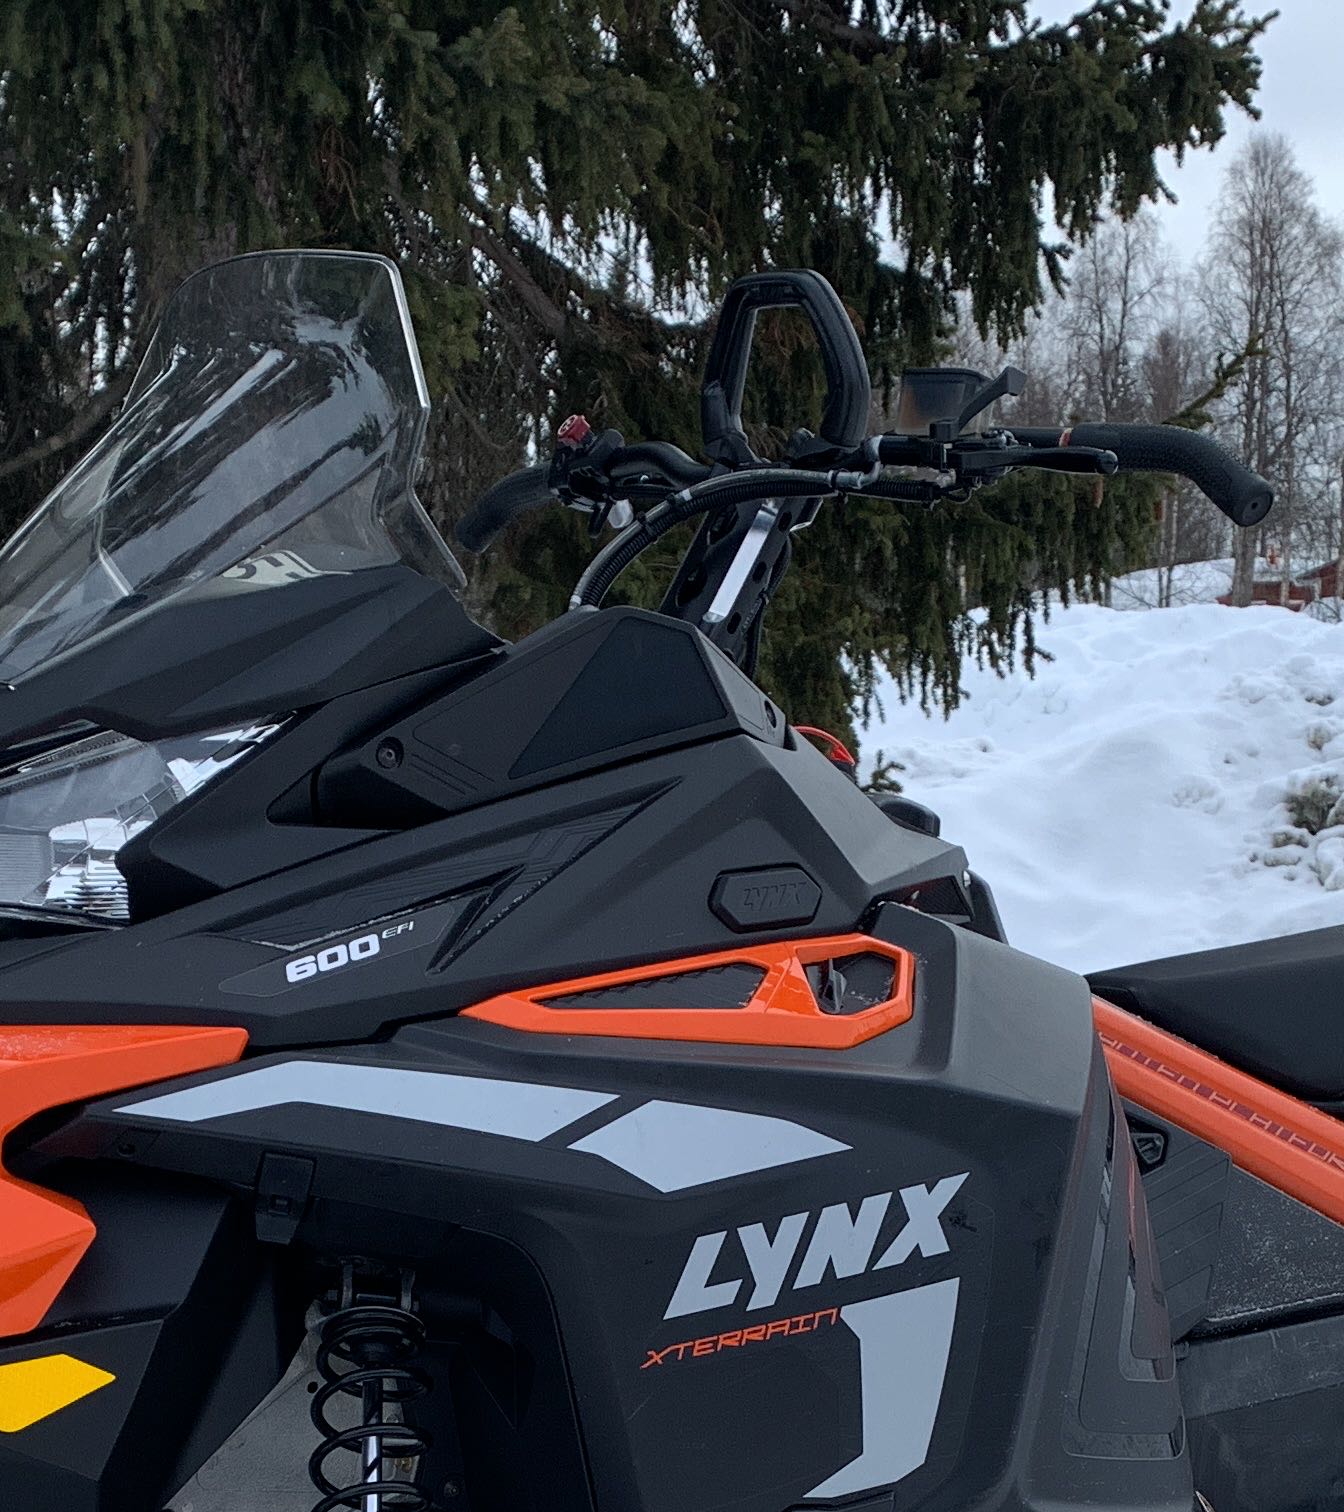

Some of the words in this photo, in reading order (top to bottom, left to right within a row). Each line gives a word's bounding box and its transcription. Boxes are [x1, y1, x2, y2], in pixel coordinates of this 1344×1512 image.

[286, 934, 380, 983] 600
[382, 921, 414, 939] EFI
[663, 1172, 970, 1320] LYNX
[640, 1307, 839, 1369] XTERRAIN
